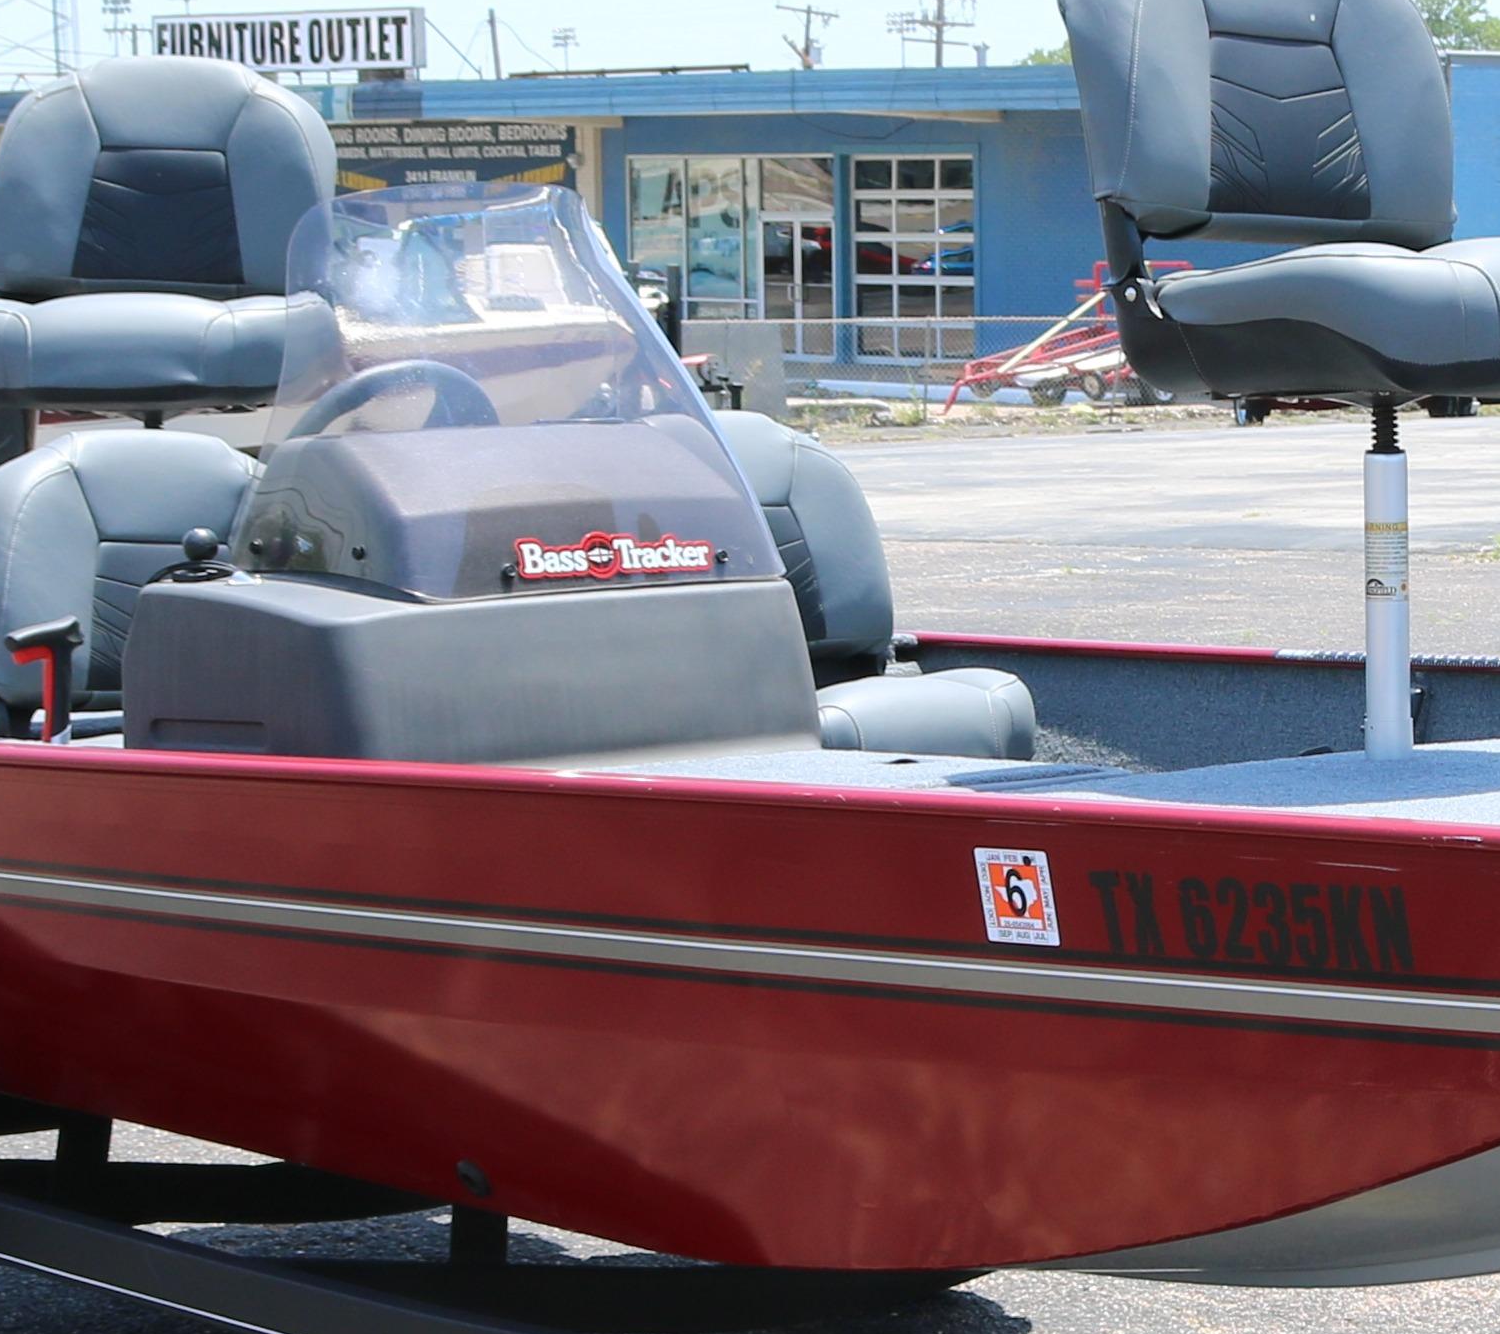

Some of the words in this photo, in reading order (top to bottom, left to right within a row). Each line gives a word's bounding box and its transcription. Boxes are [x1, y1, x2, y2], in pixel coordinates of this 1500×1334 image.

[156, 19, 302, 66] FURNITURE
[308, 15, 408, 64] OUTLET
[403, 125, 447, 143] DINING
[498, 123, 568, 142] BEDROOMS
[519, 542, 589, 574] Bass
[612, 538, 710, 569] Tracker
[1005, 868, 1028, 918] 6
[1089, 868, 1167, 957] TX
[1179, 874, 1417, 972] 6235KN
